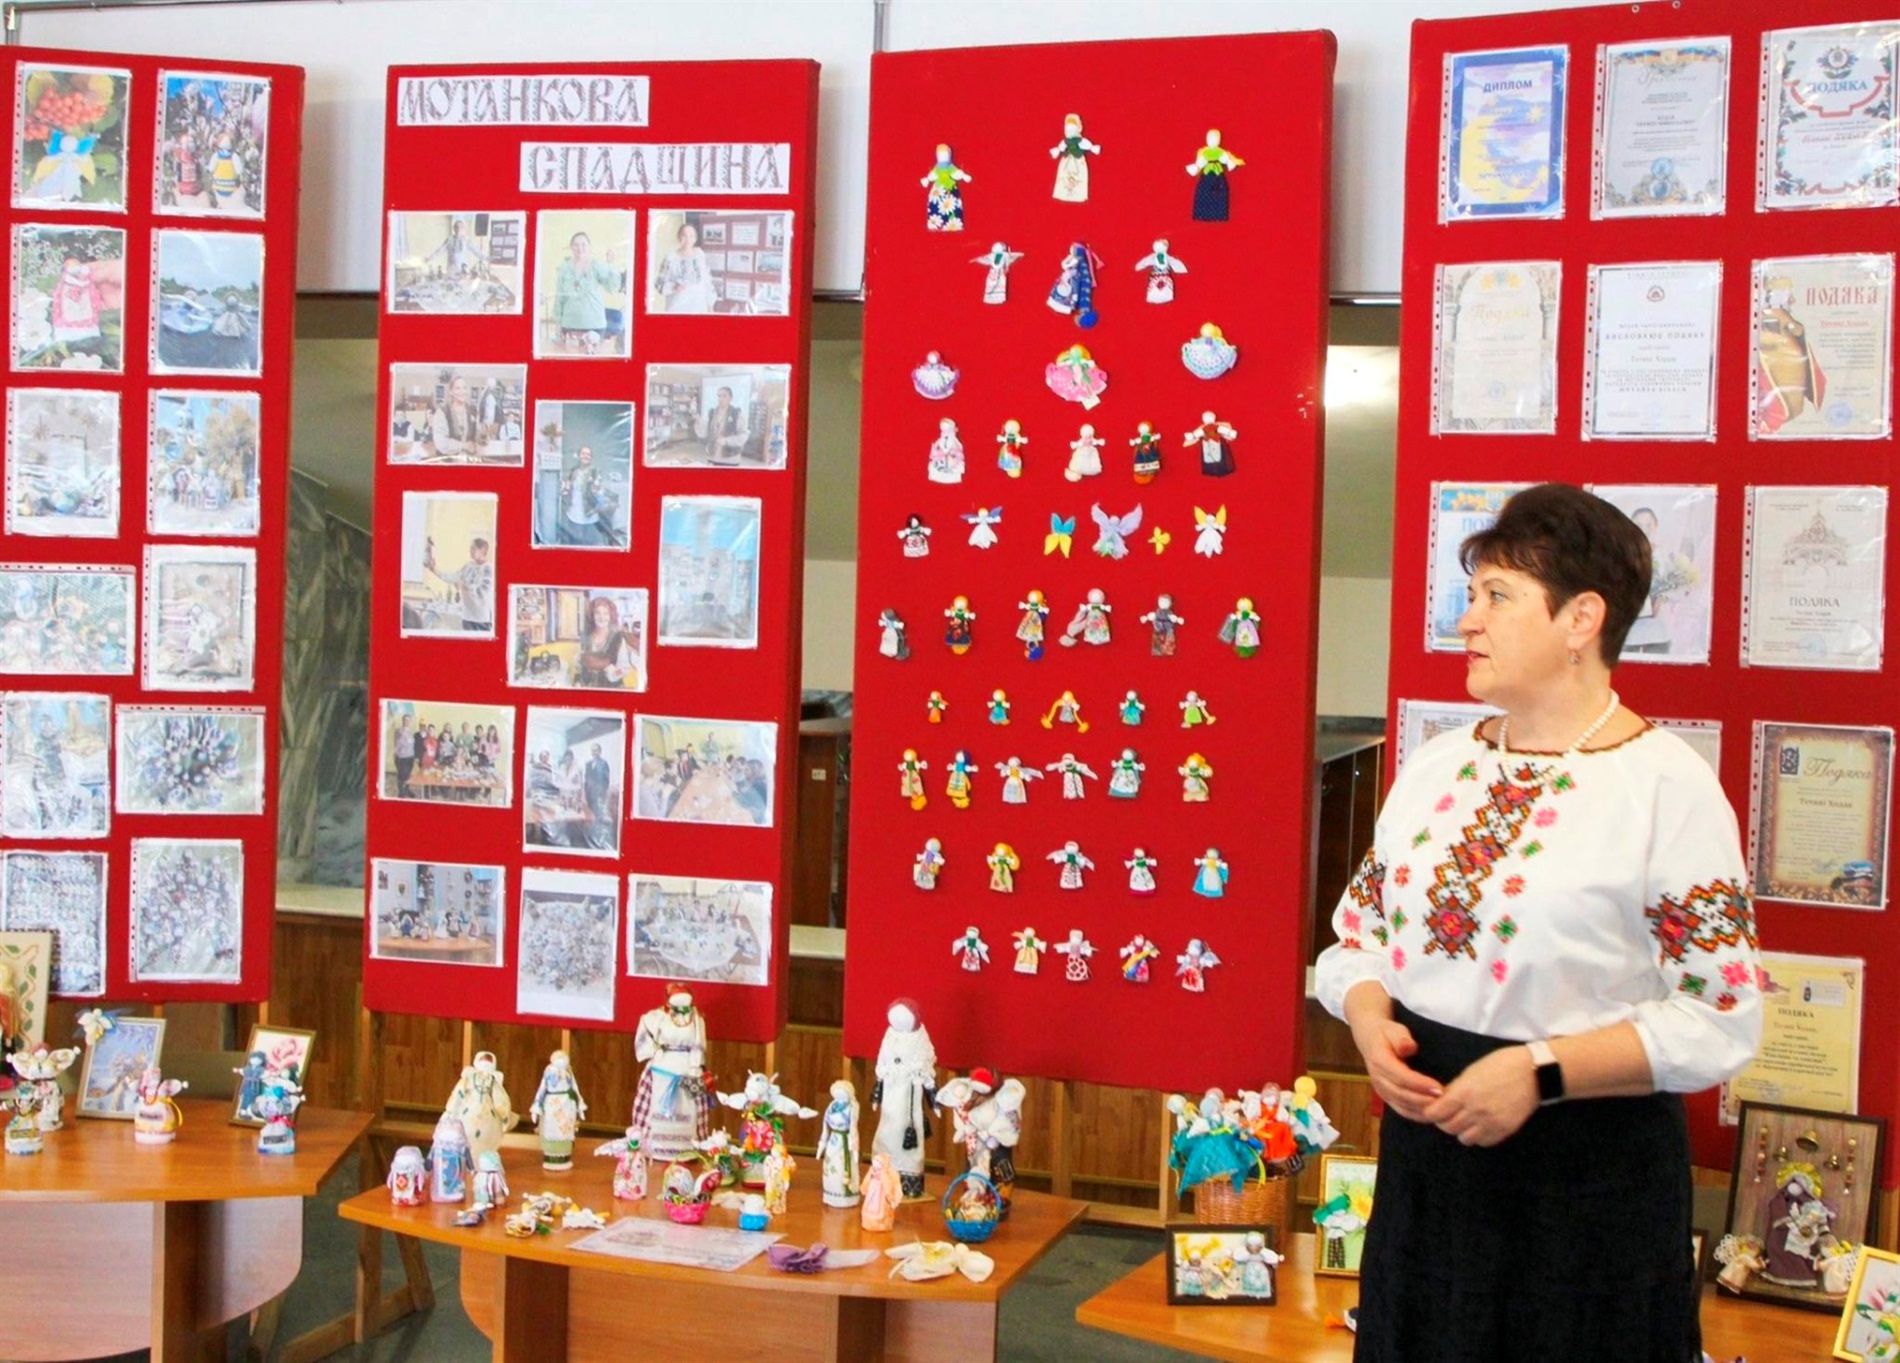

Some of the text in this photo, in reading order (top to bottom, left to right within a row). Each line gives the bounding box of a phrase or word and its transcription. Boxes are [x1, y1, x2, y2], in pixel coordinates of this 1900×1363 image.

[1483, 79, 1534, 93] ДИПЛОМ
[400, 78, 643, 122] МОТАНКОВА
[528, 145, 783, 193] СПАДЩИНА
[1806, 286, 1878, 306] ПОДЯКА
[1789, 597, 1840, 608] ПОДЯКА
